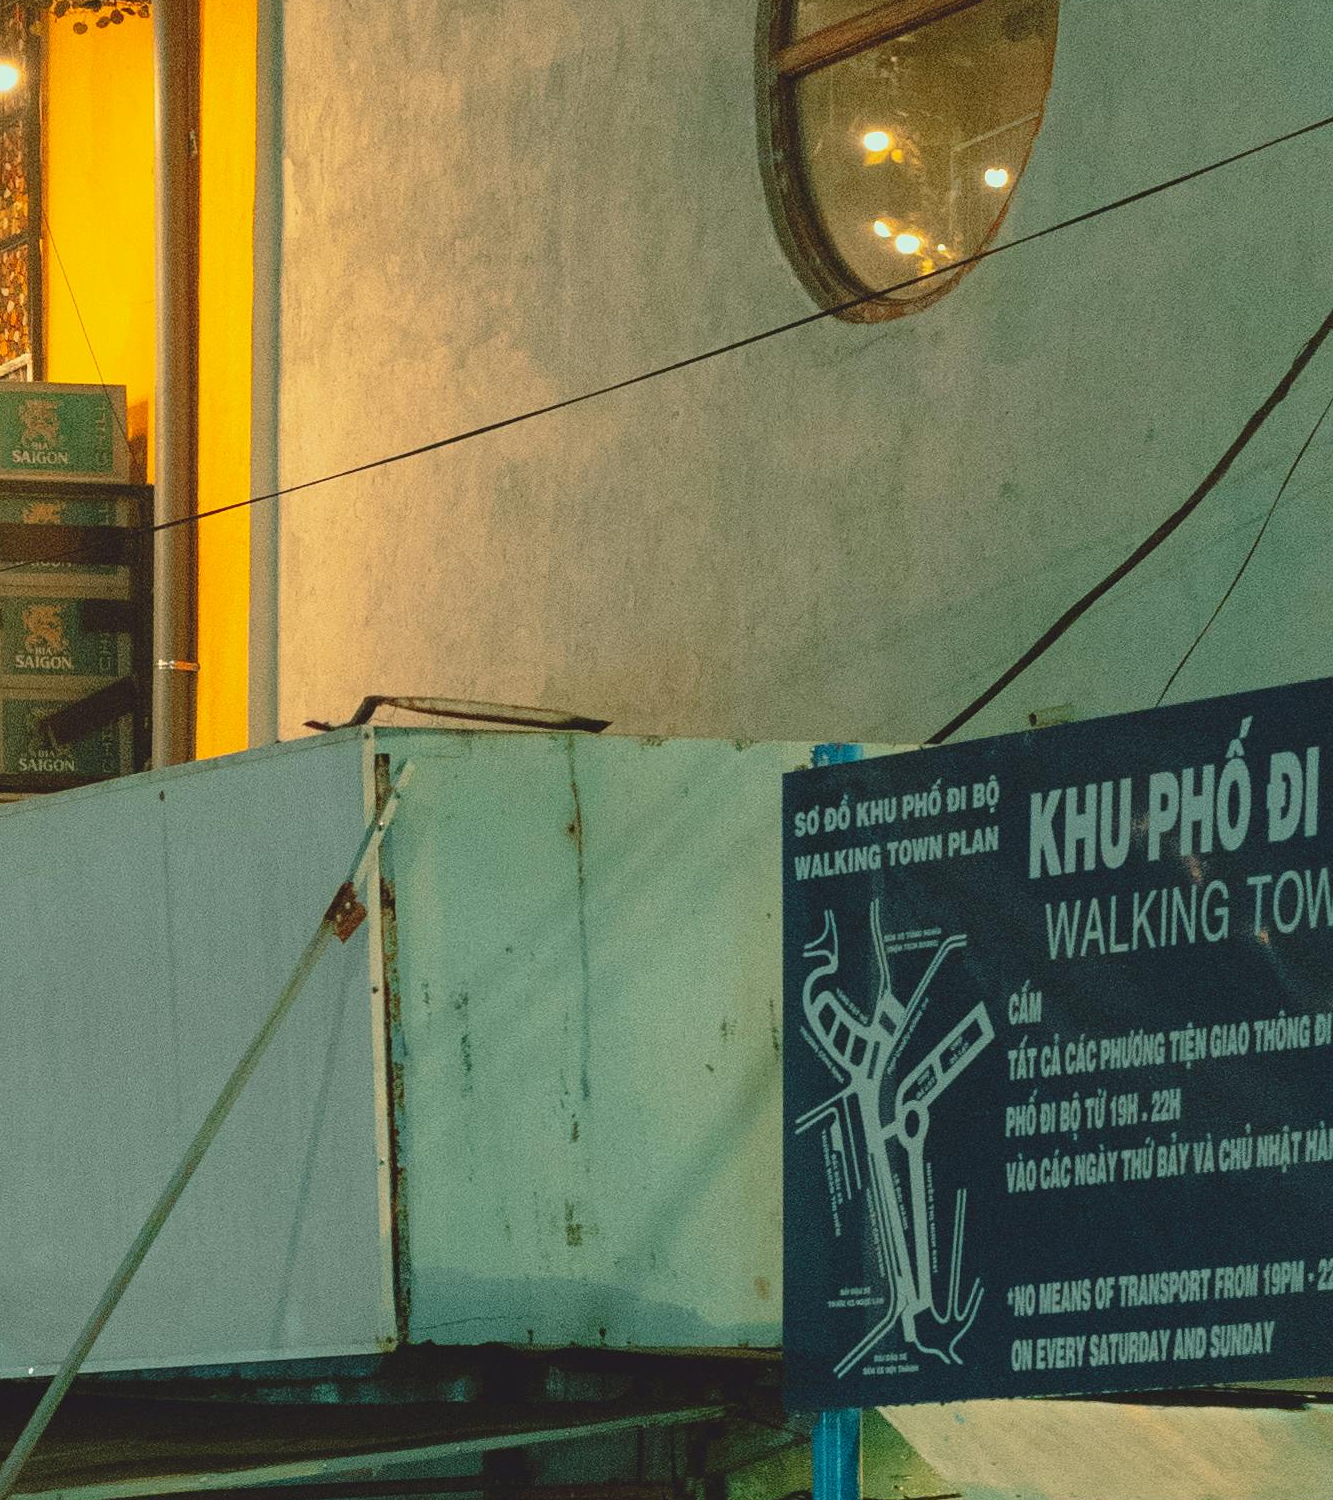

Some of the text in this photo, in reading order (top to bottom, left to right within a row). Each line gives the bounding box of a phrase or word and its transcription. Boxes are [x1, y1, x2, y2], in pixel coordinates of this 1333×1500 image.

[12, 449, 70, 465] SAIGON
[14, 655, 72, 669] SAIGON
[18, 758, 75, 772] SAIGON
[794, 775, 1000, 837] SƠ ĐỒ KHU PHỐ ĐI BỘ
[1029, 715, 1320, 880] KHU PHỐ ĐI
[794, 825, 1000, 881] WALKING TOWN PLAN
[1045, 879, 1230, 960] WALKING
[1008, 980, 1043, 1026] CẤM
[1008, 1035, 1037, 1081] TẤT
[1040, 1033, 1062, 1078] CẢ
[1065, 1033, 1097, 1075] CÁC
[1100, 1029, 1166, 1070] PHƯƠNG
[1169, 1022, 1207, 1070] TIỆN
[1210, 1021, 1250, 1058] GIAO
[1253, 1010, 1311, 1053] THÔNG
[1005, 1089, 1037, 1138] PHỐ
[1040, 1101, 1057, 1134] ĐI
[1060, 1091, 1081, 1141] BỘ
[1085, 1088, 1107, 1130] TỪ
[1110, 1093, 1139, 1127] 19H
[1151, 1088, 1182, 1123] 22H
[1006, 1153, 1036, 1193] VÀO
[1040, 1149, 1071, 1190] CÁC
[1074, 1144, 1118, 1186] NGÀY
[1121, 1137, 1155, 1181] THỨ
[1156, 1131, 1190, 1179] BẢY
[1193, 1133, 1215, 1174] VÀ
[1218, 1122, 1252, 1172] CHỦ
[1255, 1125, 1303, 1173] NHẬT
[1039, 1278, 1091, 1314] MEANS
[1094, 1276, 1116, 1310] OF
[1118, 1268, 1212, 1307] TRANSPORT
[1214, 1263, 1259, 1300] FROM
[1263, 1260, 1305, 1296] 19PM
[1011, 1320, 1276, 1372] ON EVERY SATURDAY AND SUNDAY
